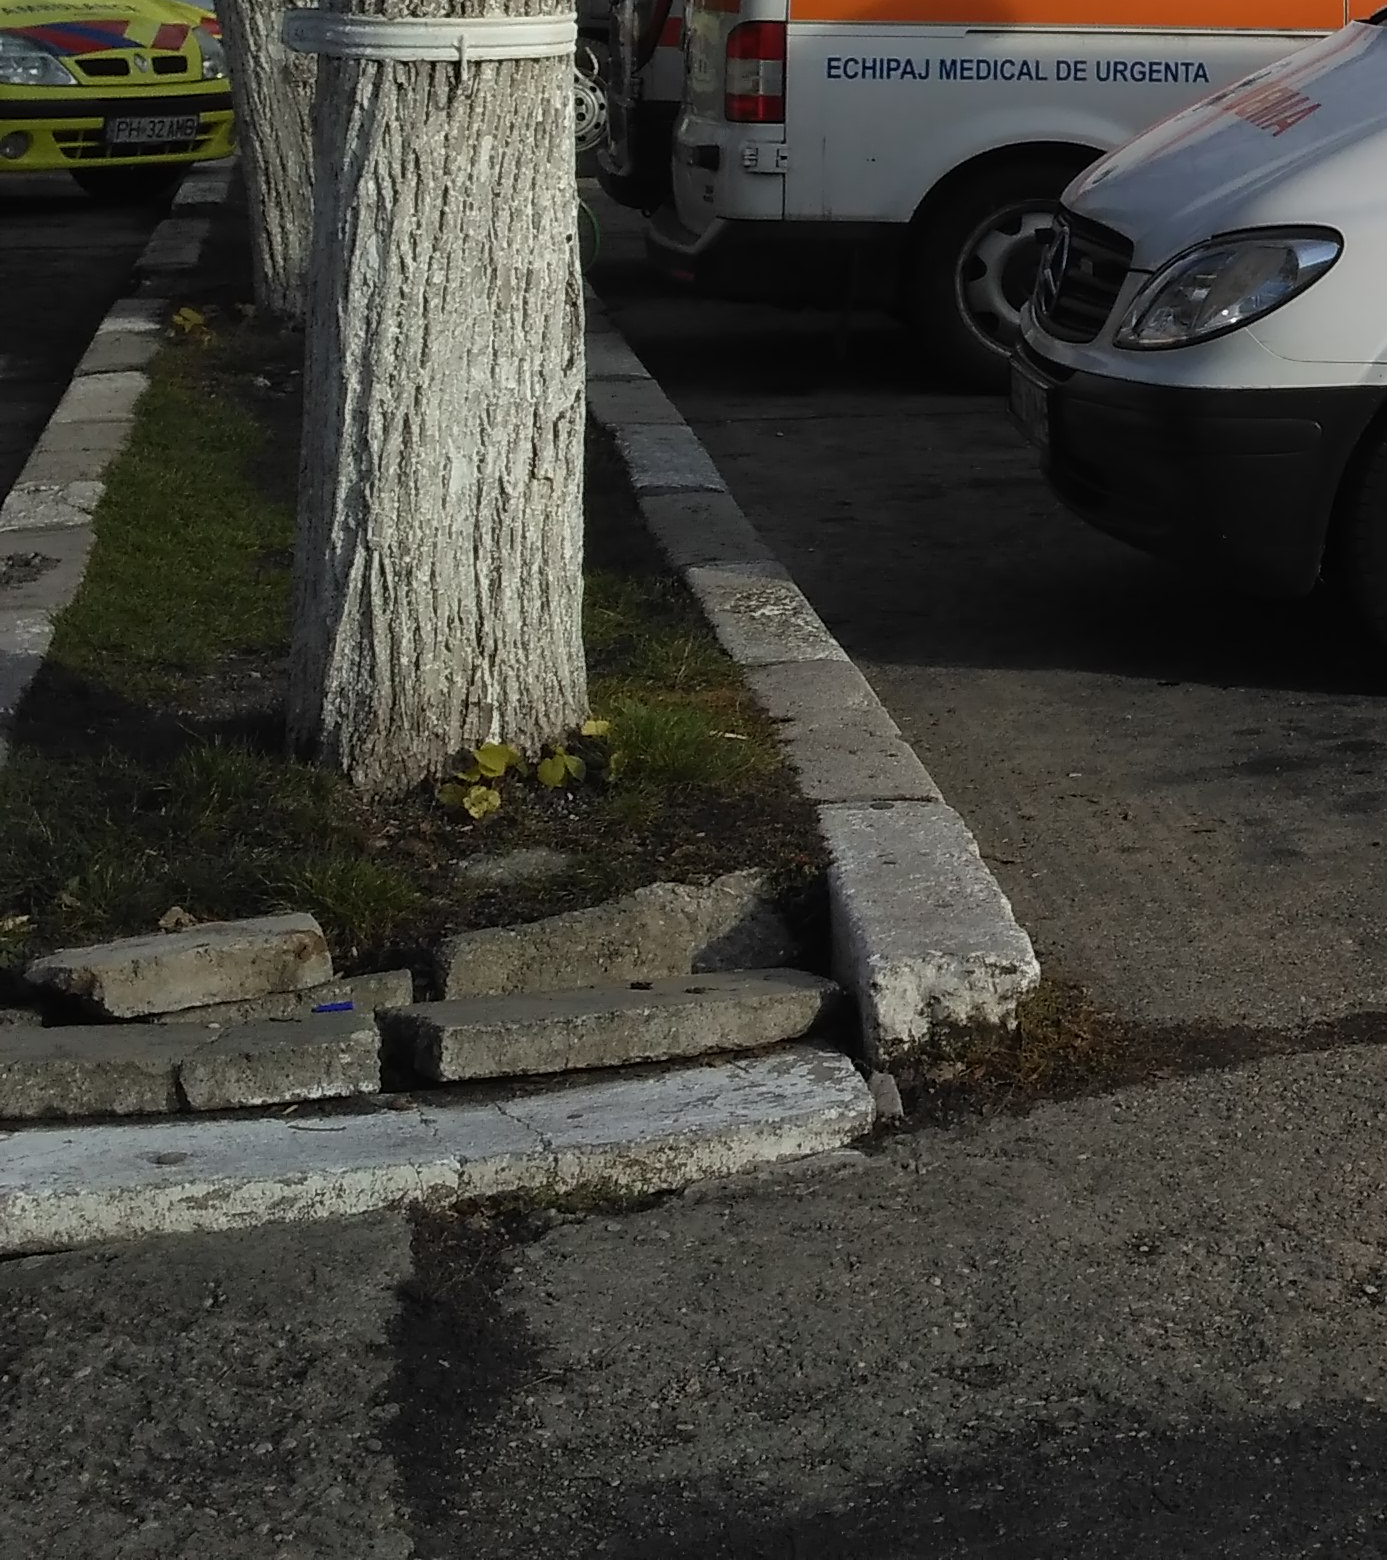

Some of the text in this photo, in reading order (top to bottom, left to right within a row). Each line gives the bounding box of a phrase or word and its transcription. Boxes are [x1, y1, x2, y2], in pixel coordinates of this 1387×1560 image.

[826, 56, 1210, 85] ECHIPAJ MEDICAL DE URGENTA
[116, 120, 141, 139] PH
